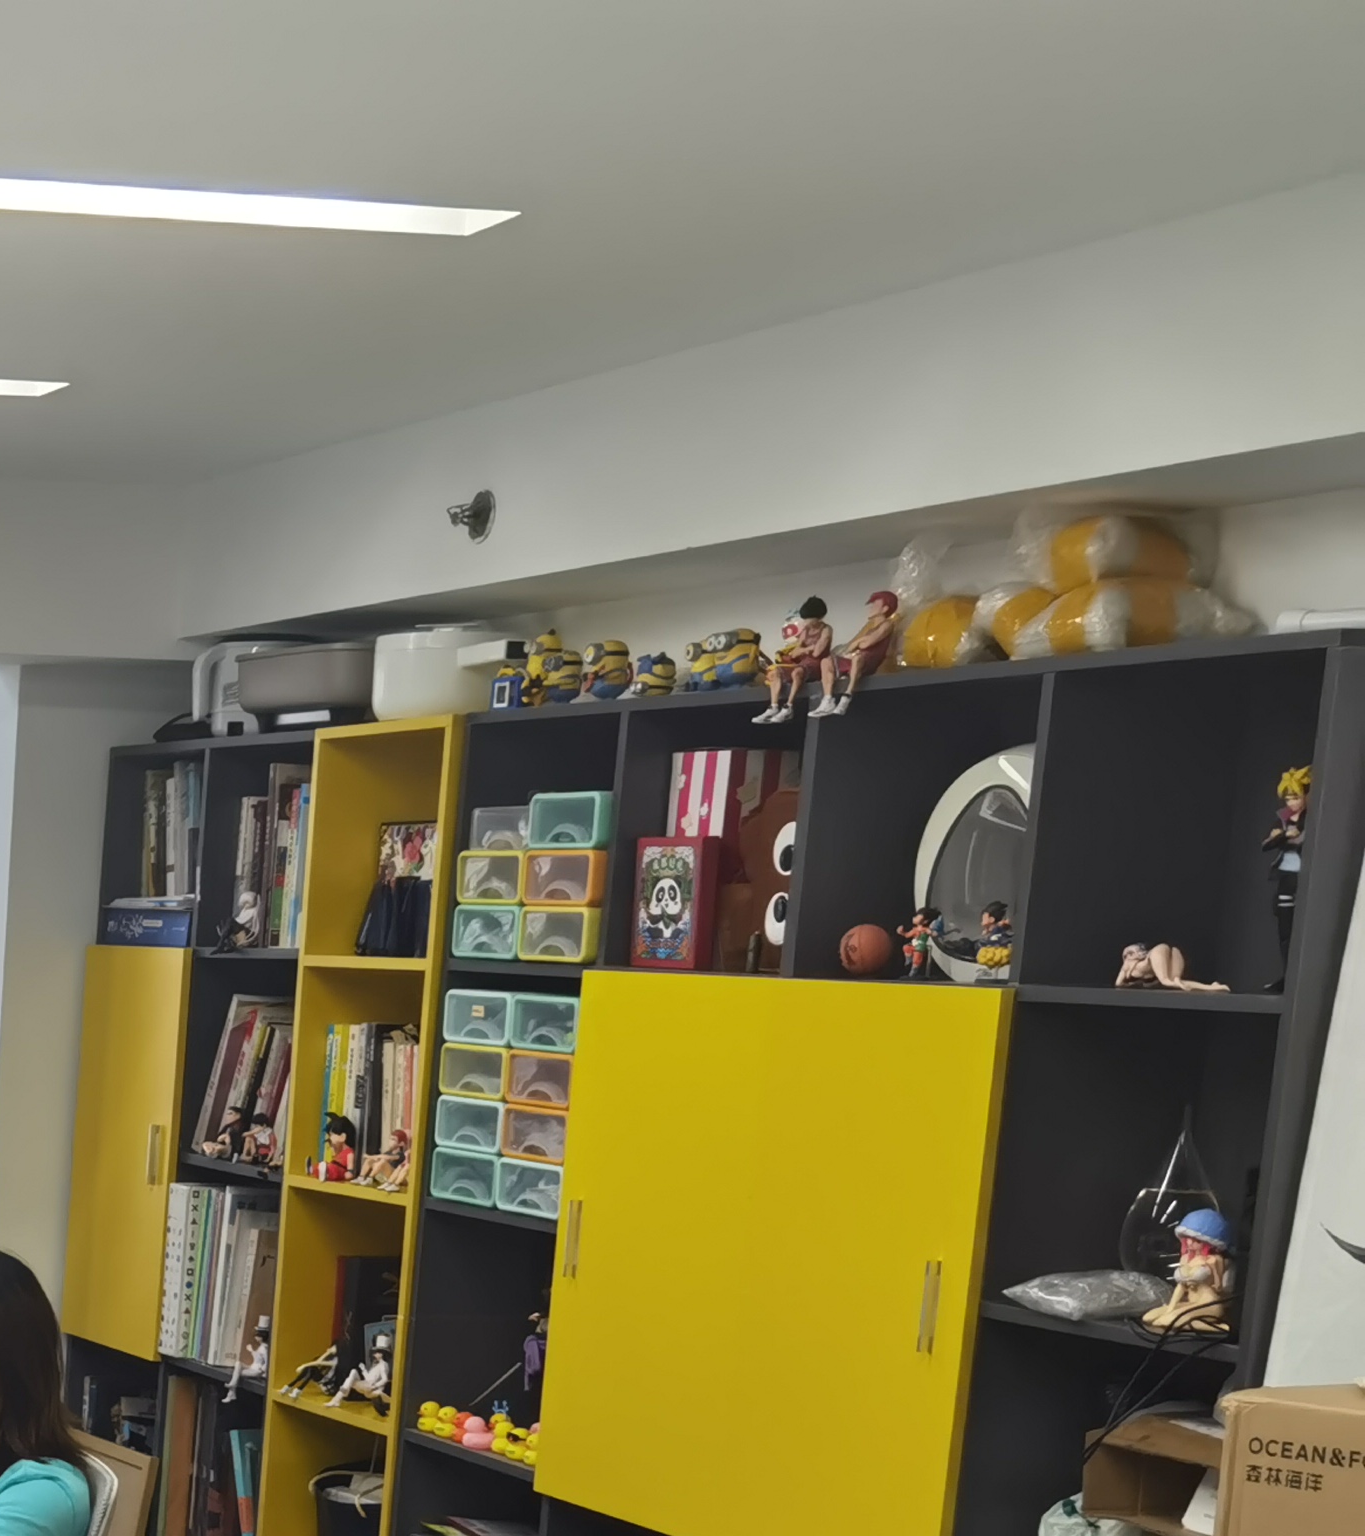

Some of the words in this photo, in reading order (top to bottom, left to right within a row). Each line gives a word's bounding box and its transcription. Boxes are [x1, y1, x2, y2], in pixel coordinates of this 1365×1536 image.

[1248, 1436, 1365, 1469] OCEAN&F
[1245, 1464, 1324, 1492] 森林海洋
